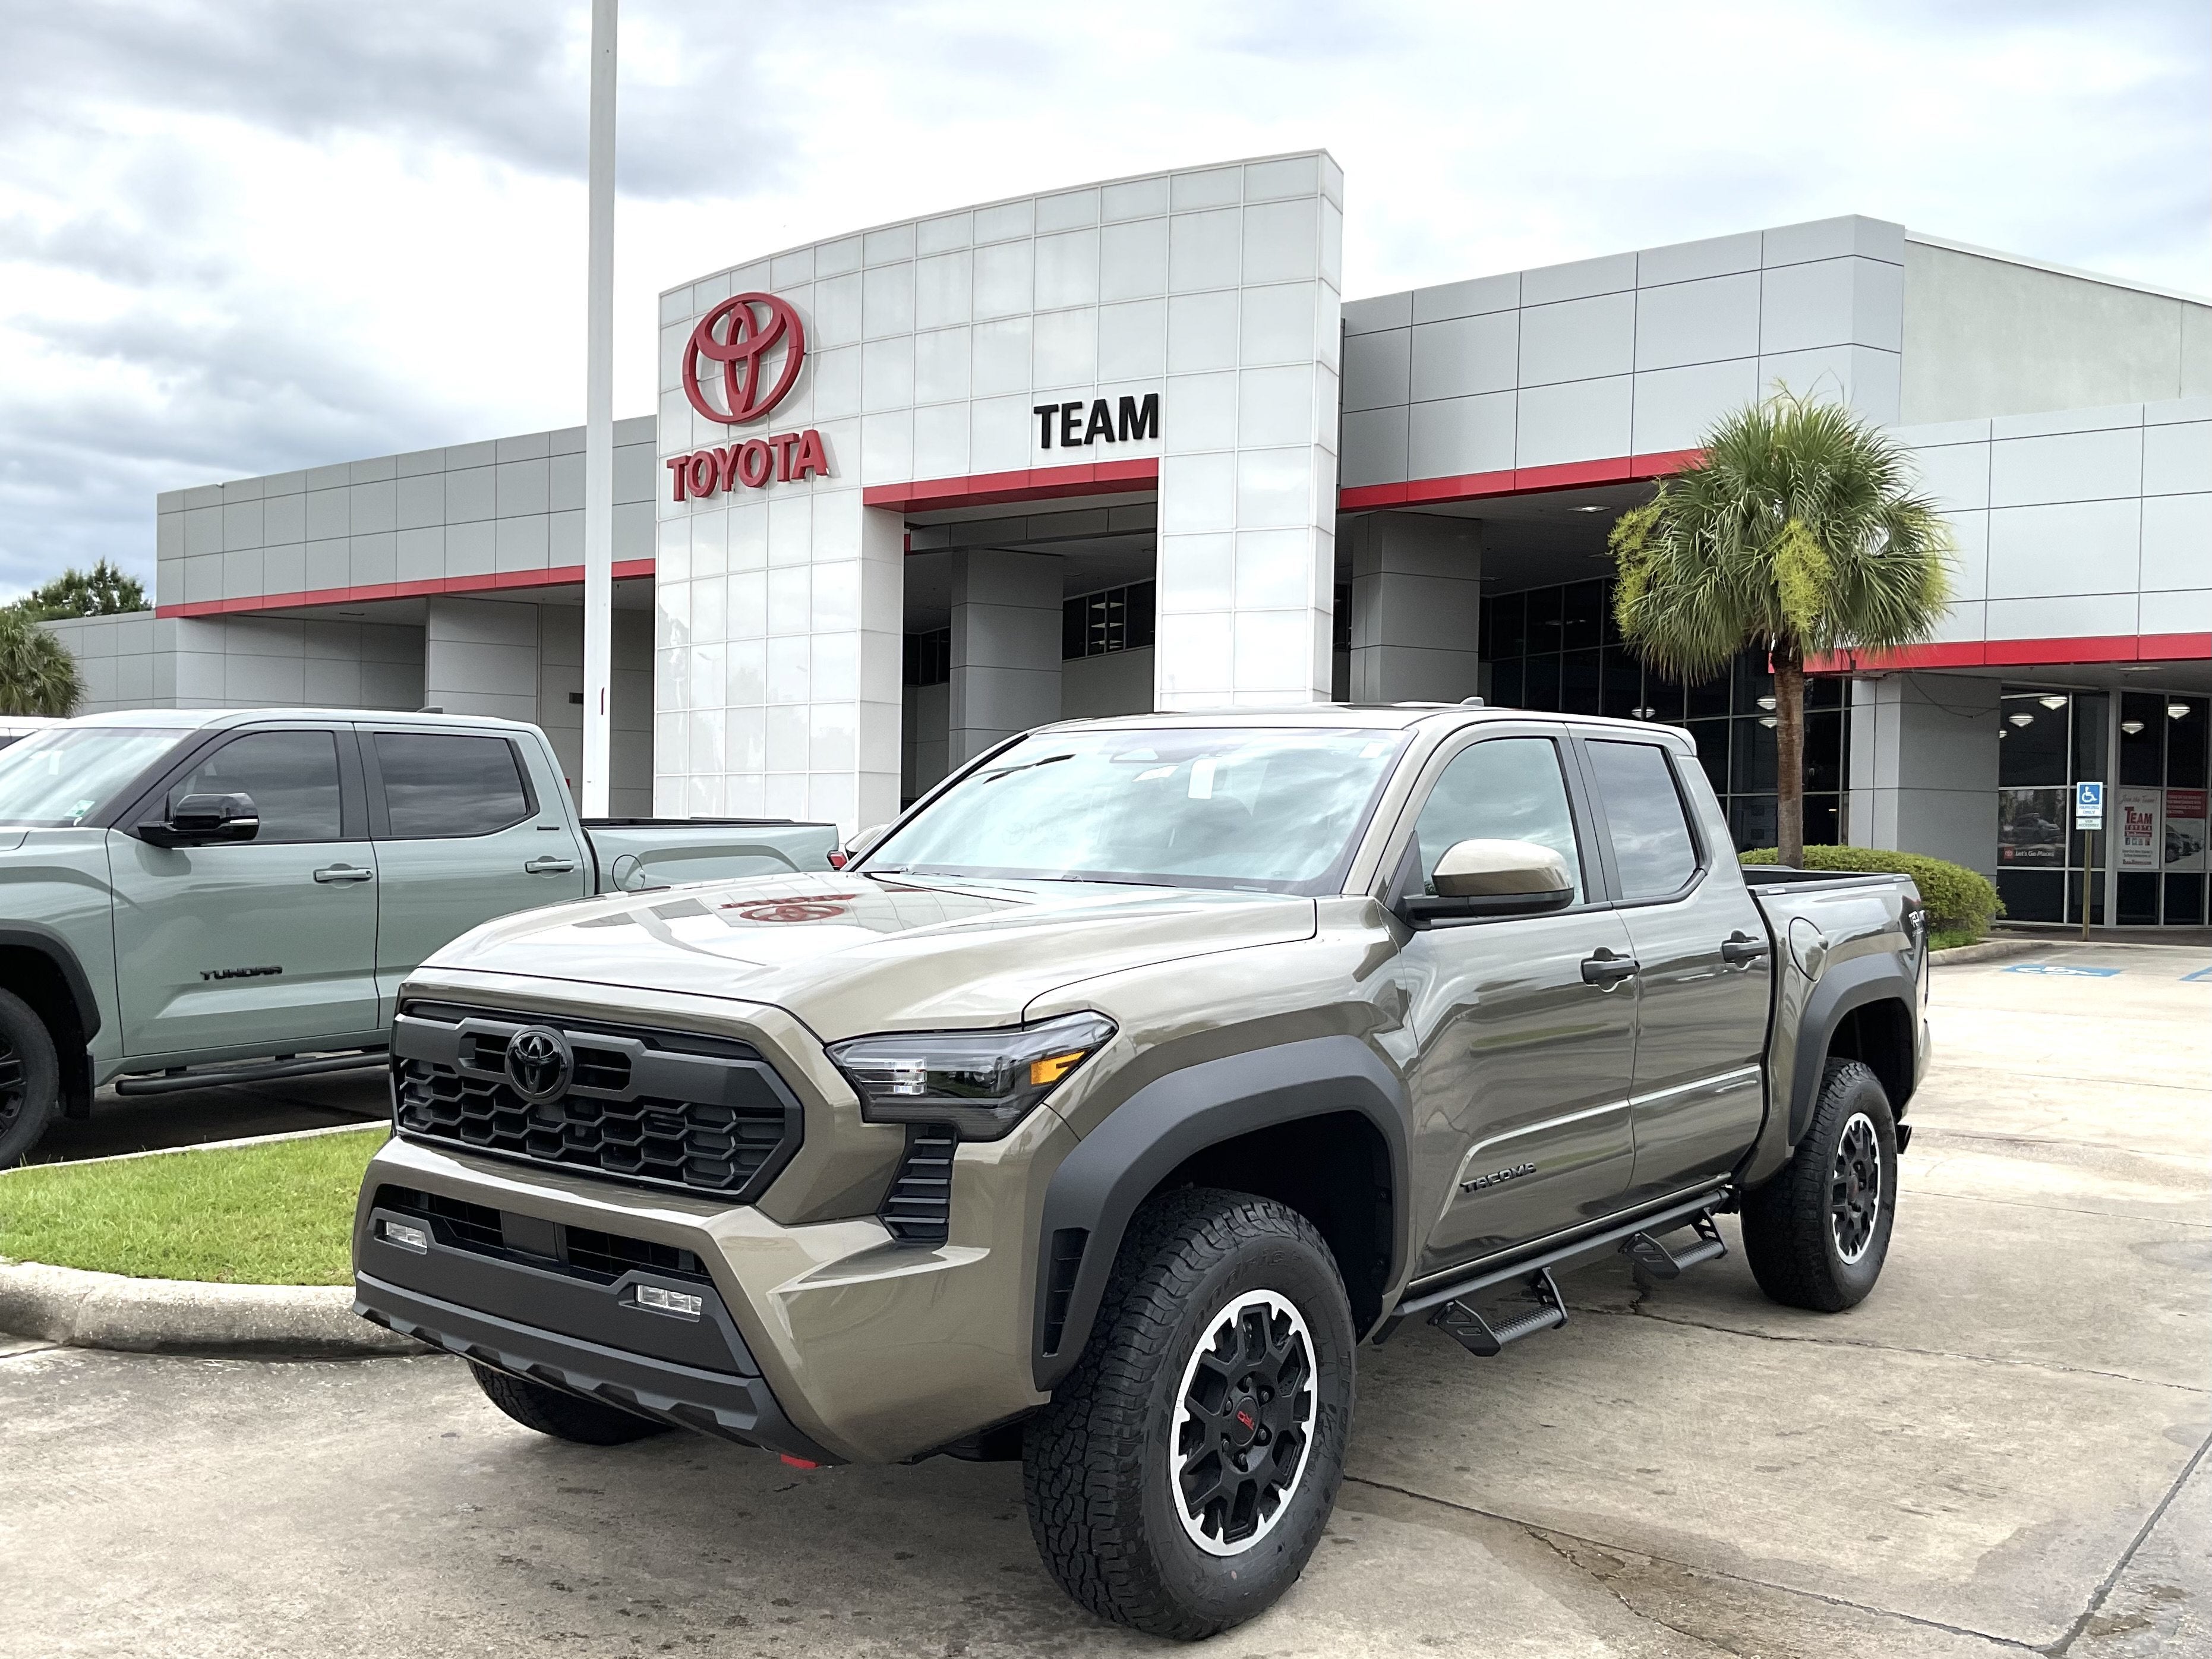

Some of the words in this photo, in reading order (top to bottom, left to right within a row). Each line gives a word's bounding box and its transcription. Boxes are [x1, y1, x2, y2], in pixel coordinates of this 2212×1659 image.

[1034, 393, 1158, 449] TEAM
[667, 429, 829, 502] TOYOTA
[2125, 806, 2153, 824] TEAM
[200, 965, 282, 980] TUNDRA
[1459, 1162, 1536, 1193] TACOMA
